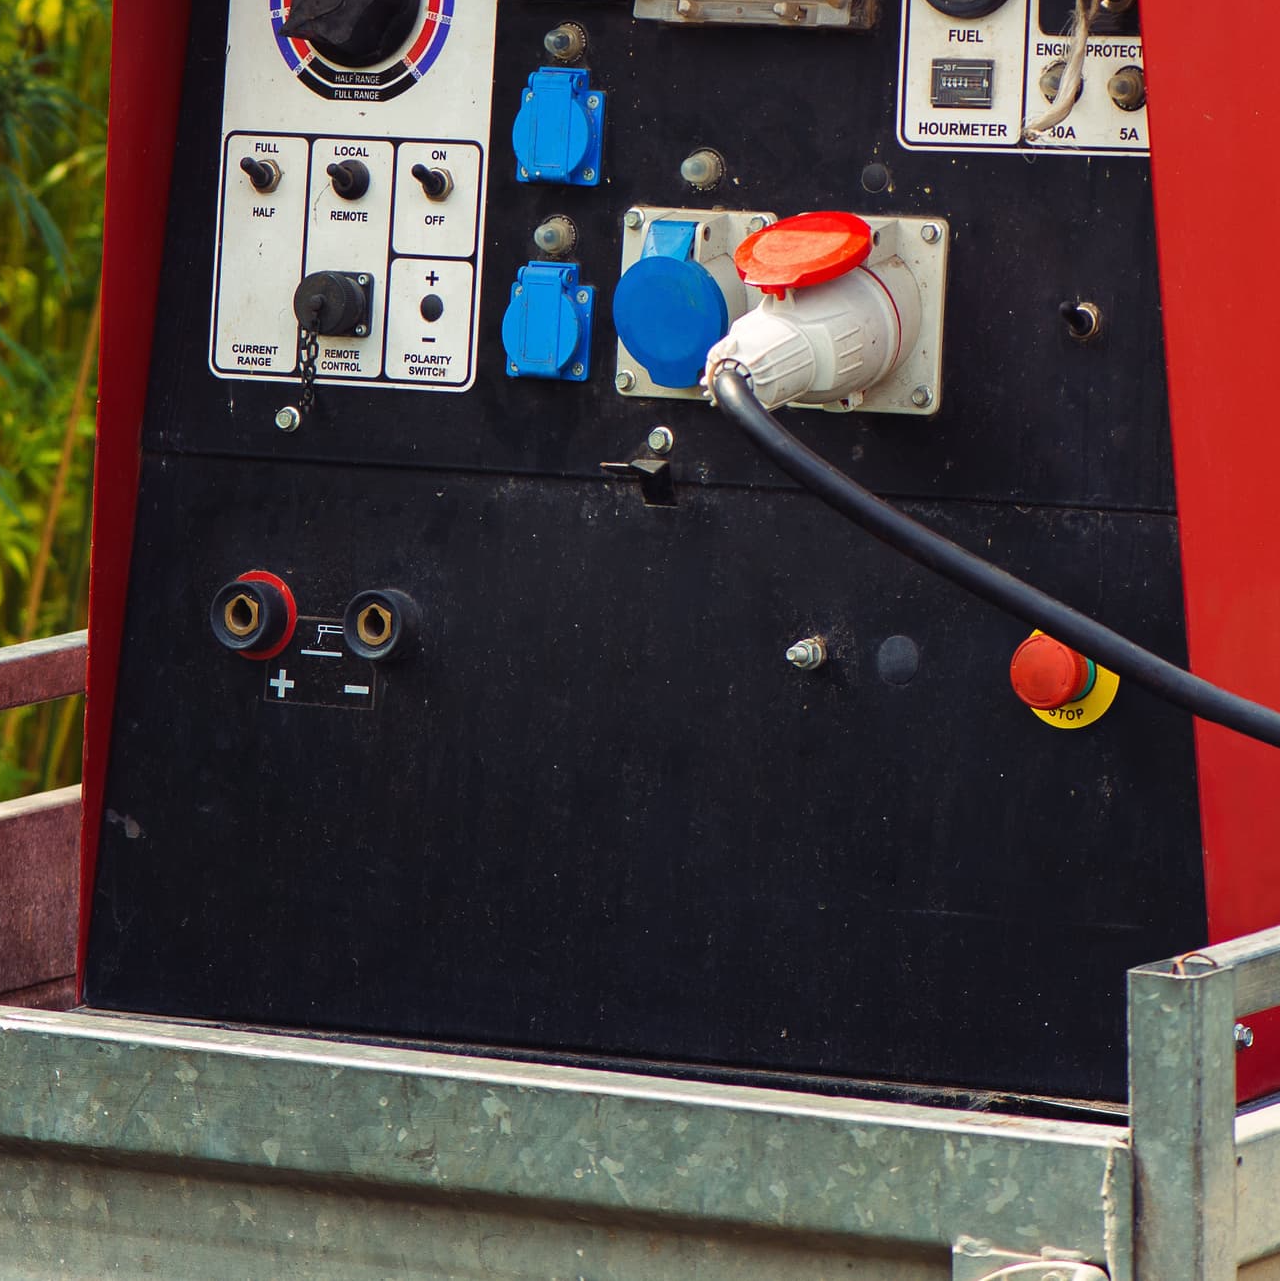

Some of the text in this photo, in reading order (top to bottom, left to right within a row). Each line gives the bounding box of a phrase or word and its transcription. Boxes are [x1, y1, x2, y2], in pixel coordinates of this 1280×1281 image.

[948, 29, 984, 43] FUEL
[335, 74, 380, 85] HALF RANGE
[334, 90, 380, 100] FULL RANGE
[918, 122, 1008, 137] HOURMETER
[1049, 126, 1076, 139] 30A
[1119, 128, 1140, 141] 5A
[255, 142, 279, 154] FULL
[334, 146, 370, 158] LOCAL
[431, 150, 447, 161] ON
[252, 207, 276, 218] HALF
[330, 210, 368, 222] REMOTE
[424, 215, 445, 226] OFF
[231, 344, 279, 356] CURRENT
[324, 348, 360, 360] REMOTE
[237, 356, 271, 367] RANGE
[403, 353, 452, 366] POLARITY
[321, 360, 362, 372] CONTROL
[408, 366, 446, 378] SWITCH
[1048, 708, 1084, 721] STOP
